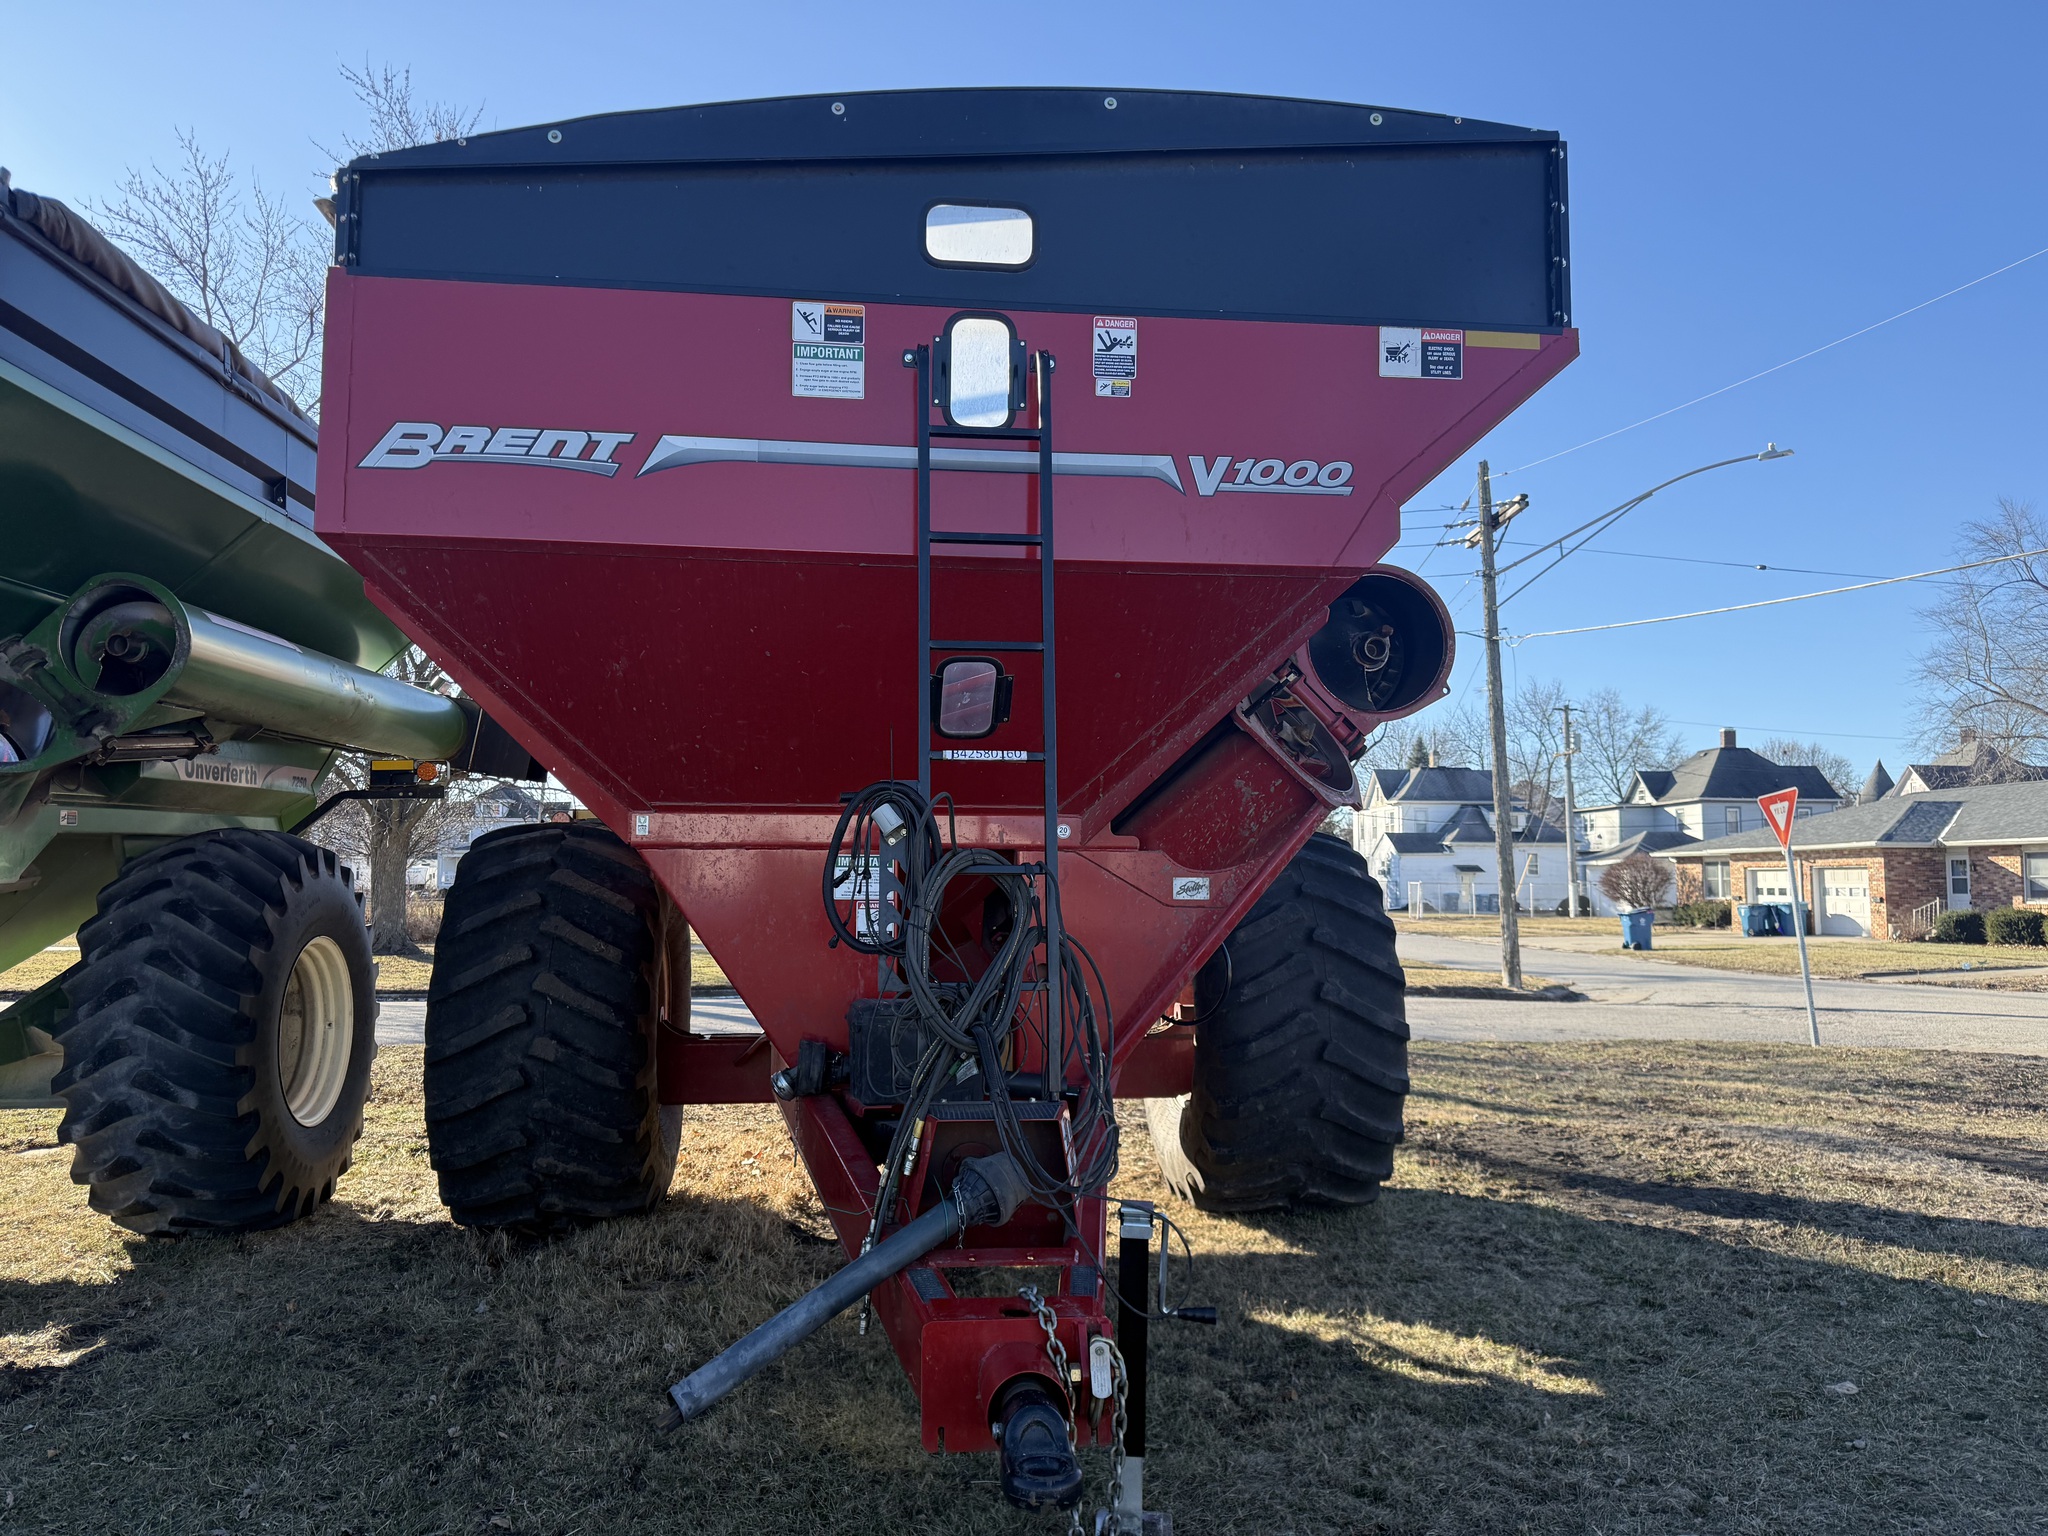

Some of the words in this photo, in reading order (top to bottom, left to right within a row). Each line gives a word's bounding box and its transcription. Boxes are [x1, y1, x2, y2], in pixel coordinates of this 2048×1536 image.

[1104, 319, 1134, 328] DANGER
[796, 346, 860, 360] IMPORTANT
[356, 420, 636, 471] BRENT
[1187, 454, 1355, 497] V1000
[952, 750, 1022, 759] B4258060
[184, 760, 258, 786] Unverferth
